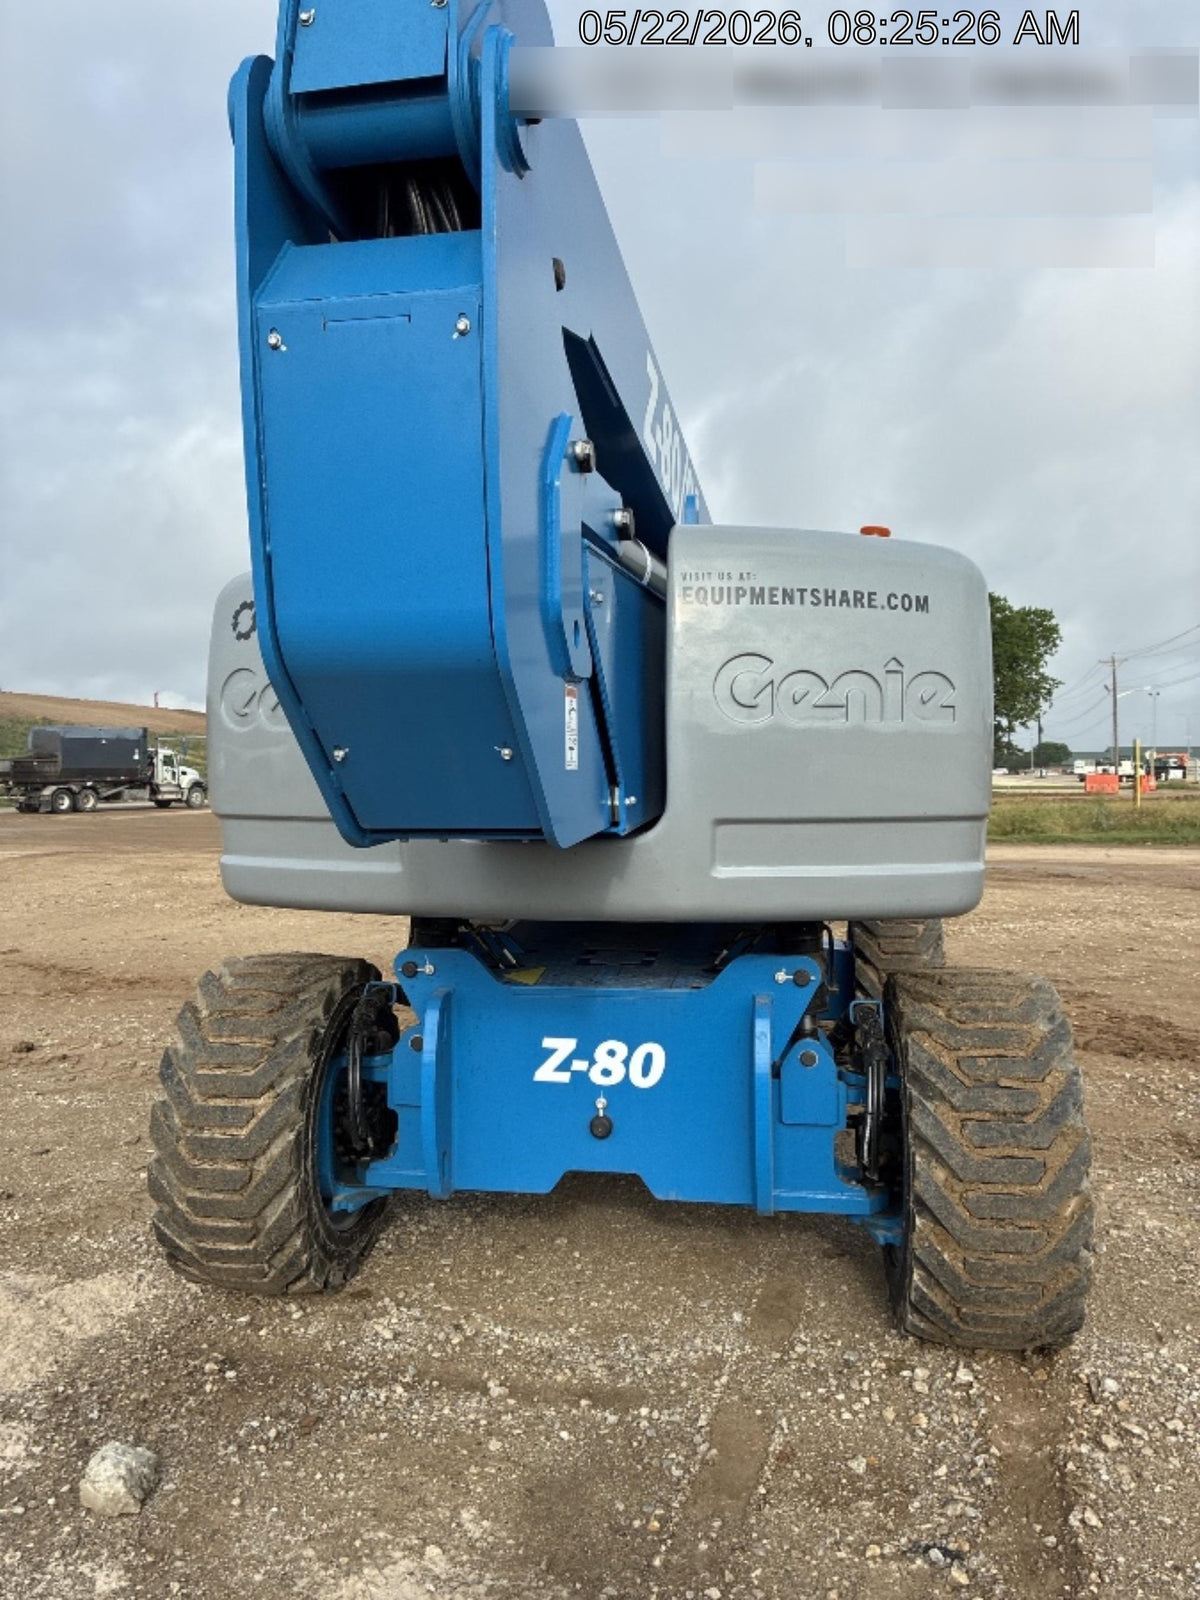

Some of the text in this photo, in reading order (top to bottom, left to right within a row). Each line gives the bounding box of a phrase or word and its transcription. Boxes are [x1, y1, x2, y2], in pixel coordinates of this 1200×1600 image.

[681, 572, 757, 581] VISIT US AT:
[682, 586, 929, 613] EQUIPMENTSHARE.COM
[713, 651, 956, 725] Genie
[533, 1037, 666, 1089] Z-80
